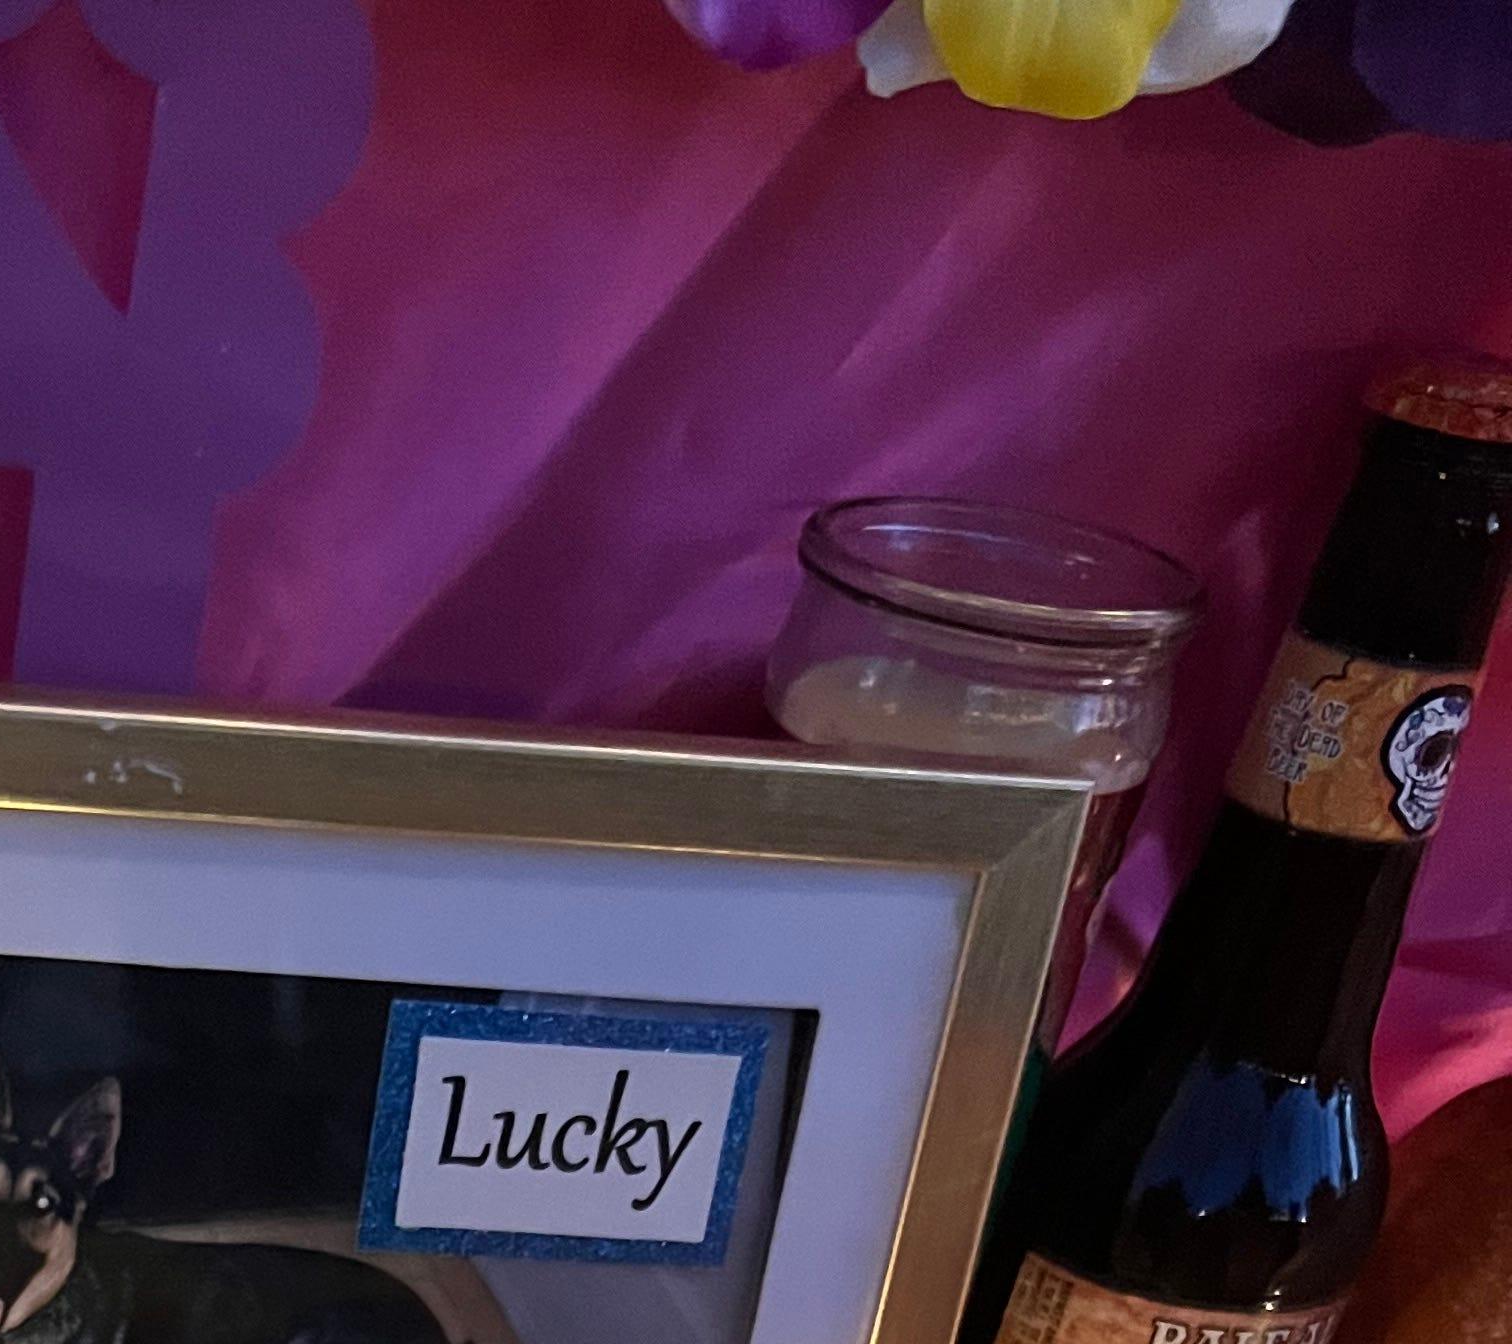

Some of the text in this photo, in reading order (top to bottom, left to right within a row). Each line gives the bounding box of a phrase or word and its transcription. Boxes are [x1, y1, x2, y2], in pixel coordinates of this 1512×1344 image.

[1321, 701, 1347, 724] OF
[1296, 724, 1342, 759] DEAD
[1268, 747, 1308, 781] BEER
[438, 1069, 702, 1210] Lucky
